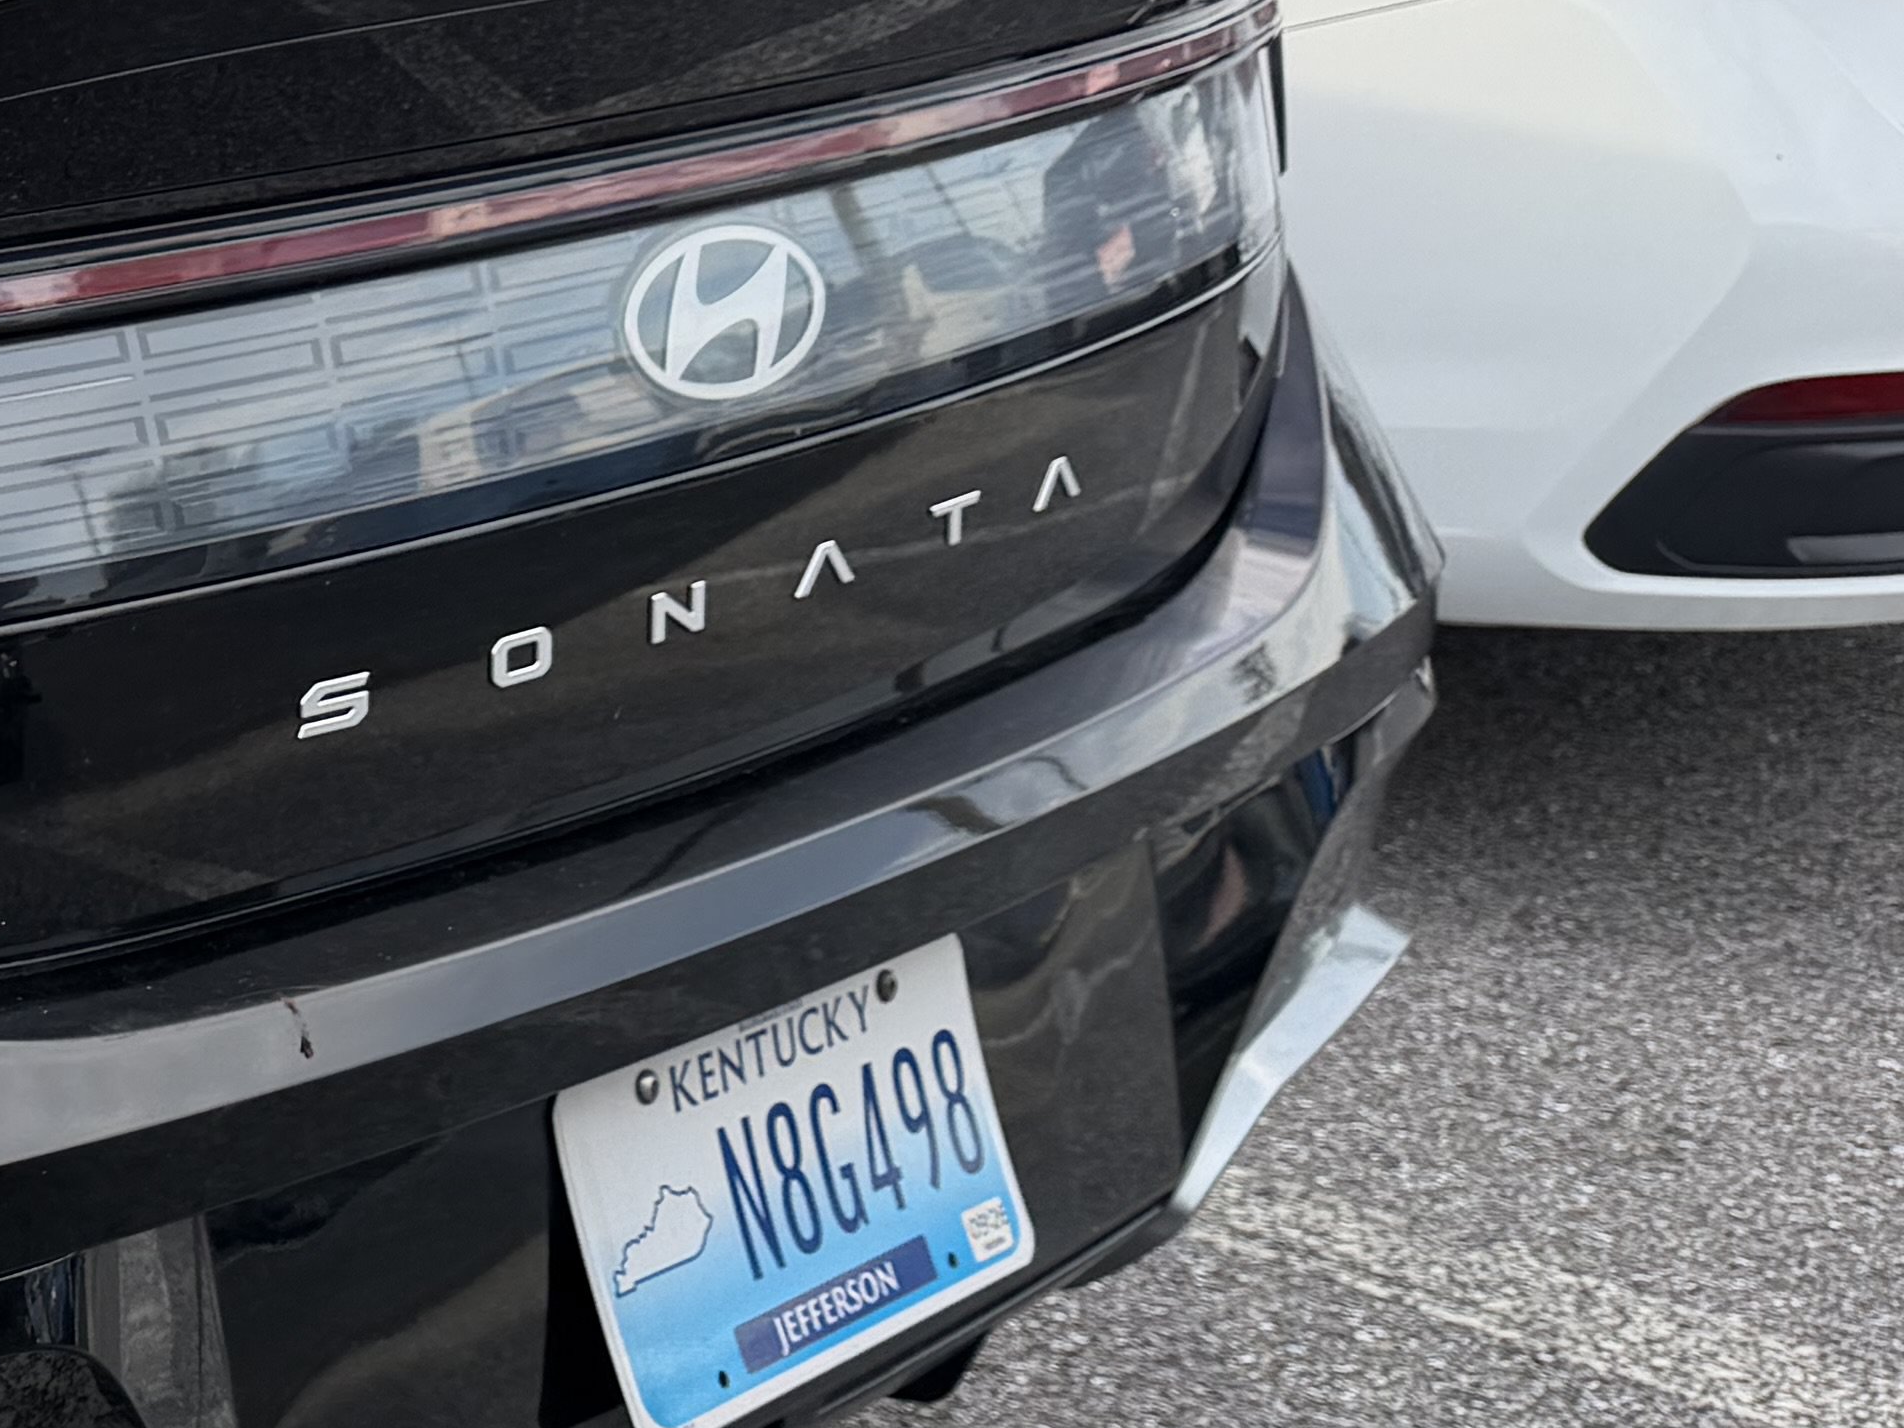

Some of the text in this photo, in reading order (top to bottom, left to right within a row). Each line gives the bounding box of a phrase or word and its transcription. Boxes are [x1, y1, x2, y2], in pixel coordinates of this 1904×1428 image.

[296, 454, 1083, 740] SONATA
[668, 984, 870, 1114] KENTUCKY
[716, 1029, 985, 1280] N8G498
[773, 1260, 901, 1356] JEFFERSON
